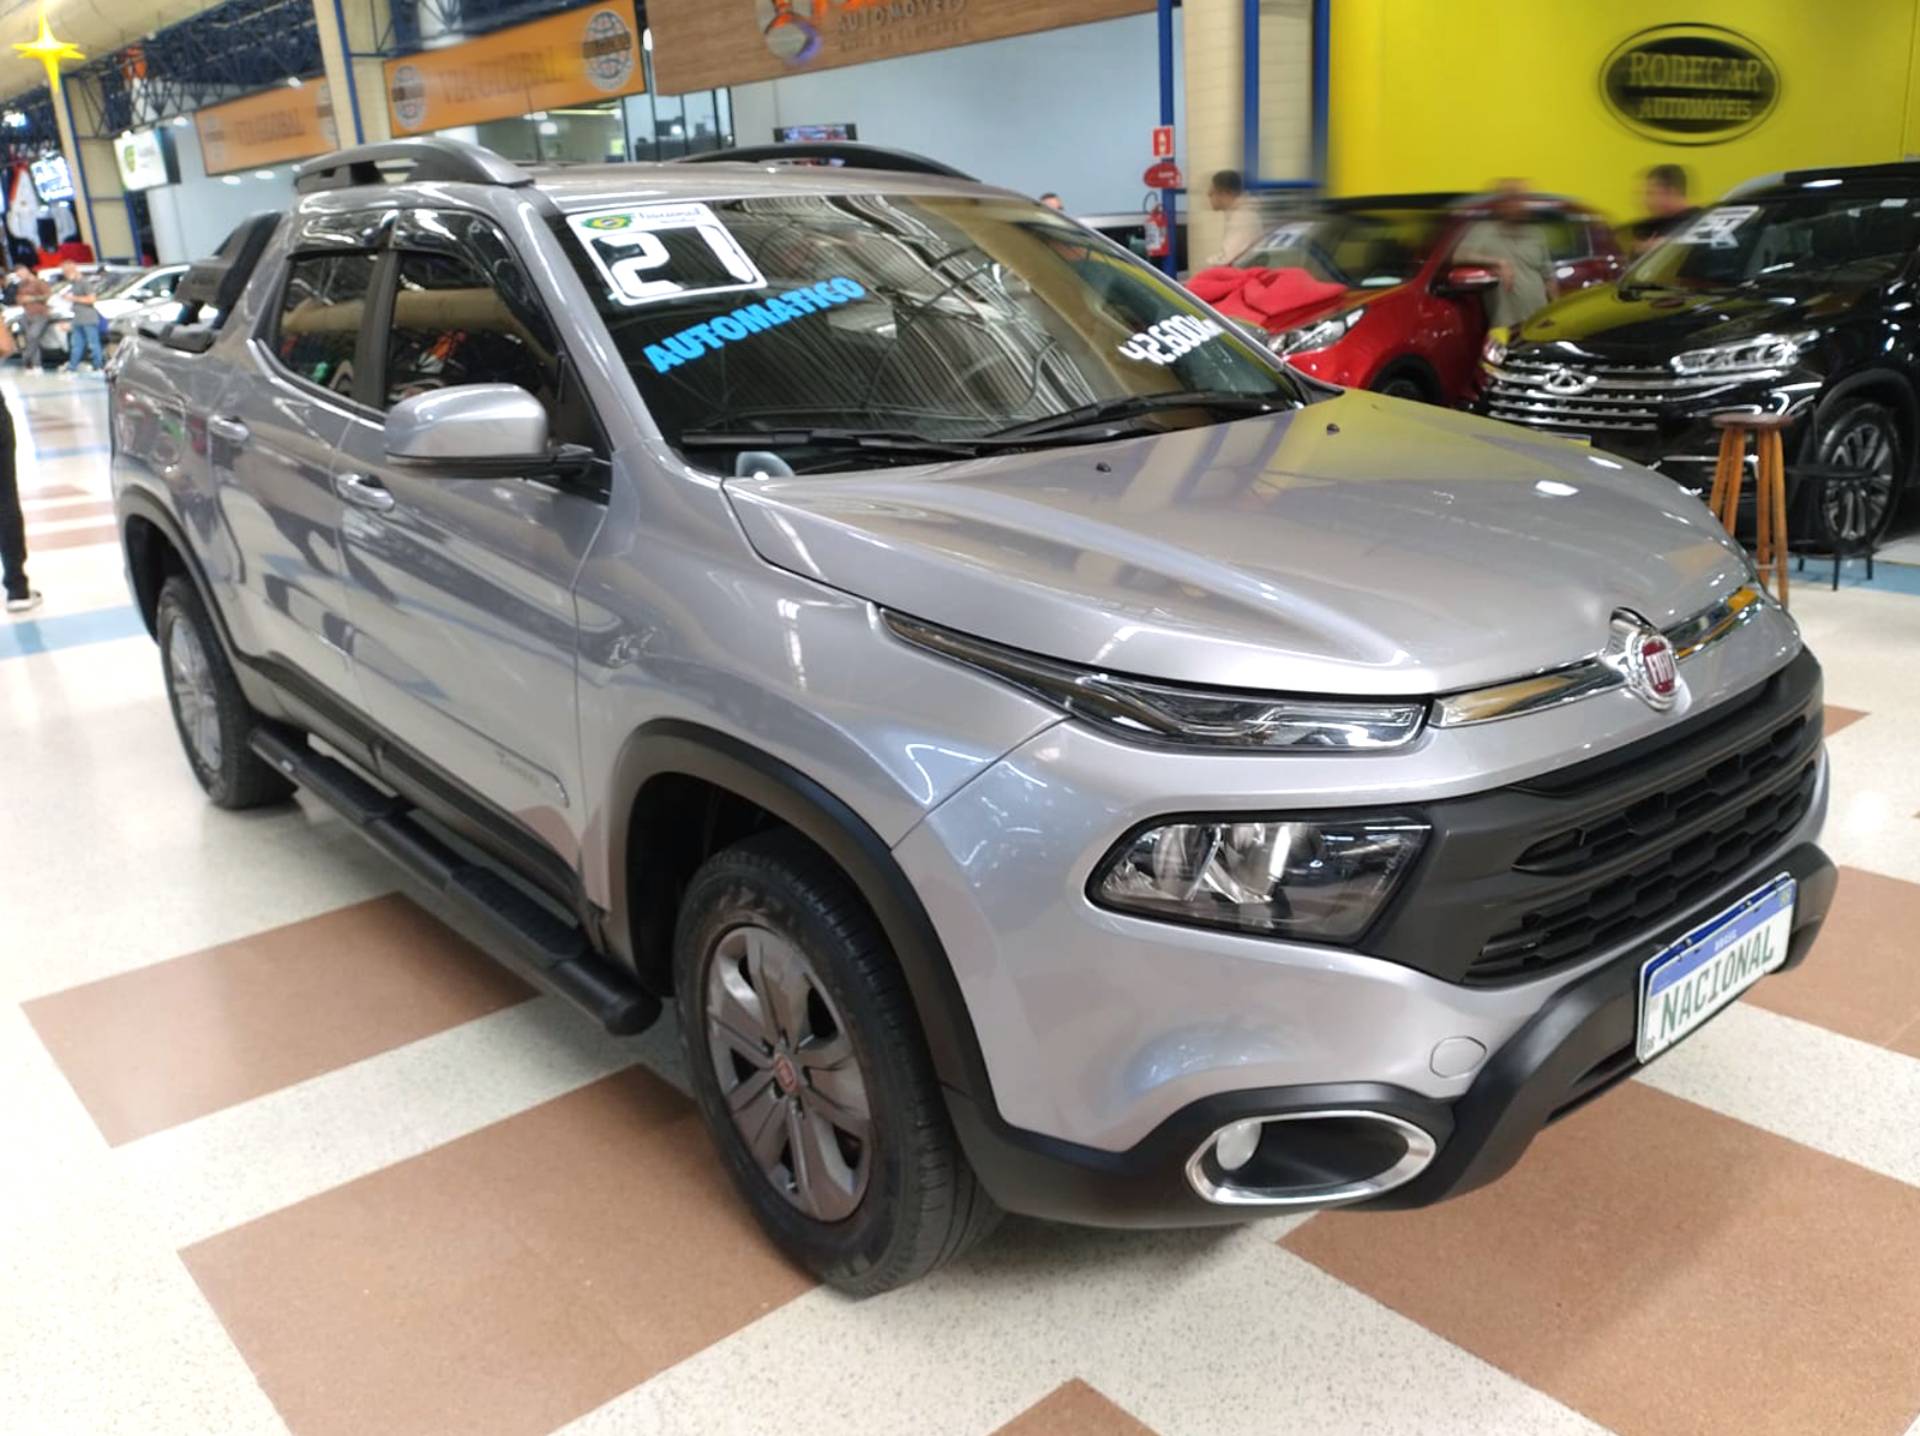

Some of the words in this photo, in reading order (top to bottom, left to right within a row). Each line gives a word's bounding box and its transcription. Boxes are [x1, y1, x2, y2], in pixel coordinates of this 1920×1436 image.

[1627, 51, 1762, 92] RODECAR
[643, 276, 866, 374] AUTOMATICO
[1660, 924, 1775, 1041] NACIONAL
